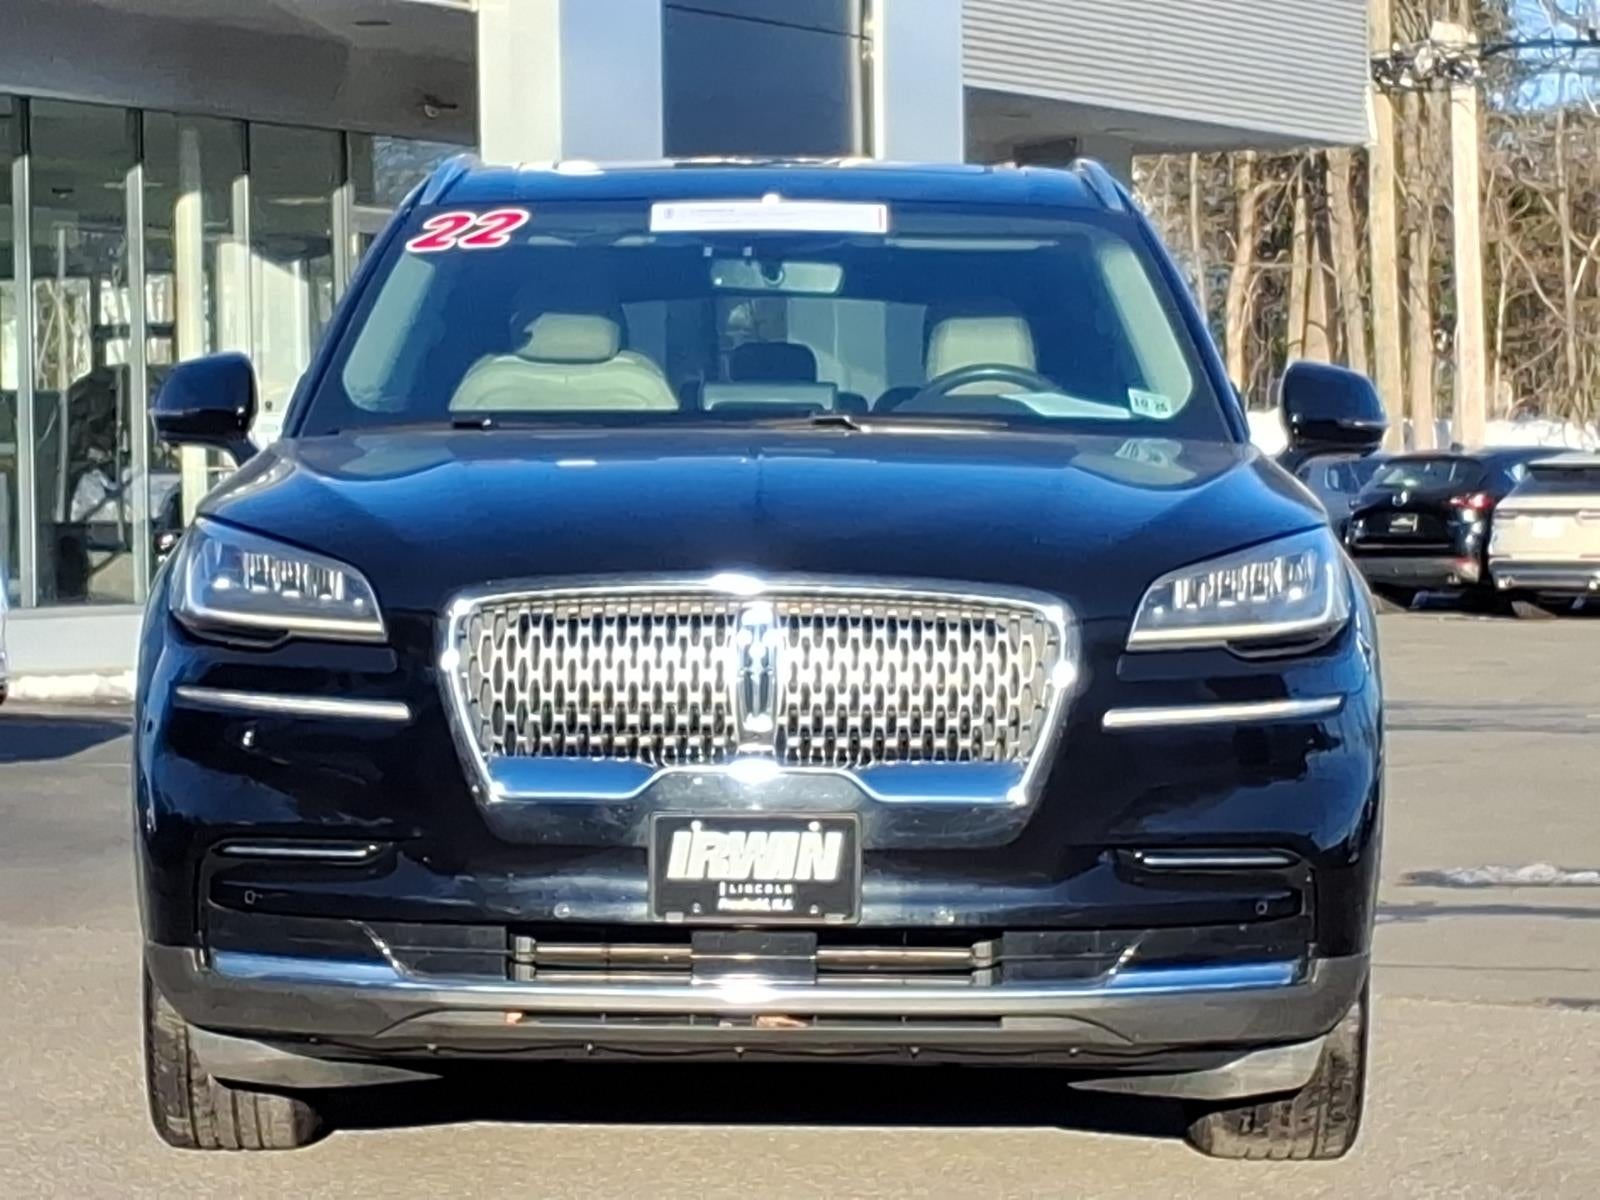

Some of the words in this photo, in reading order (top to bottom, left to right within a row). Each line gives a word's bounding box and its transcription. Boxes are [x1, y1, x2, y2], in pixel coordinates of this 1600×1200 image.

[406, 208, 530, 252] 22
[666, 830, 844, 881] IRWIN
[728, 883, 794, 895] LINCOLN
